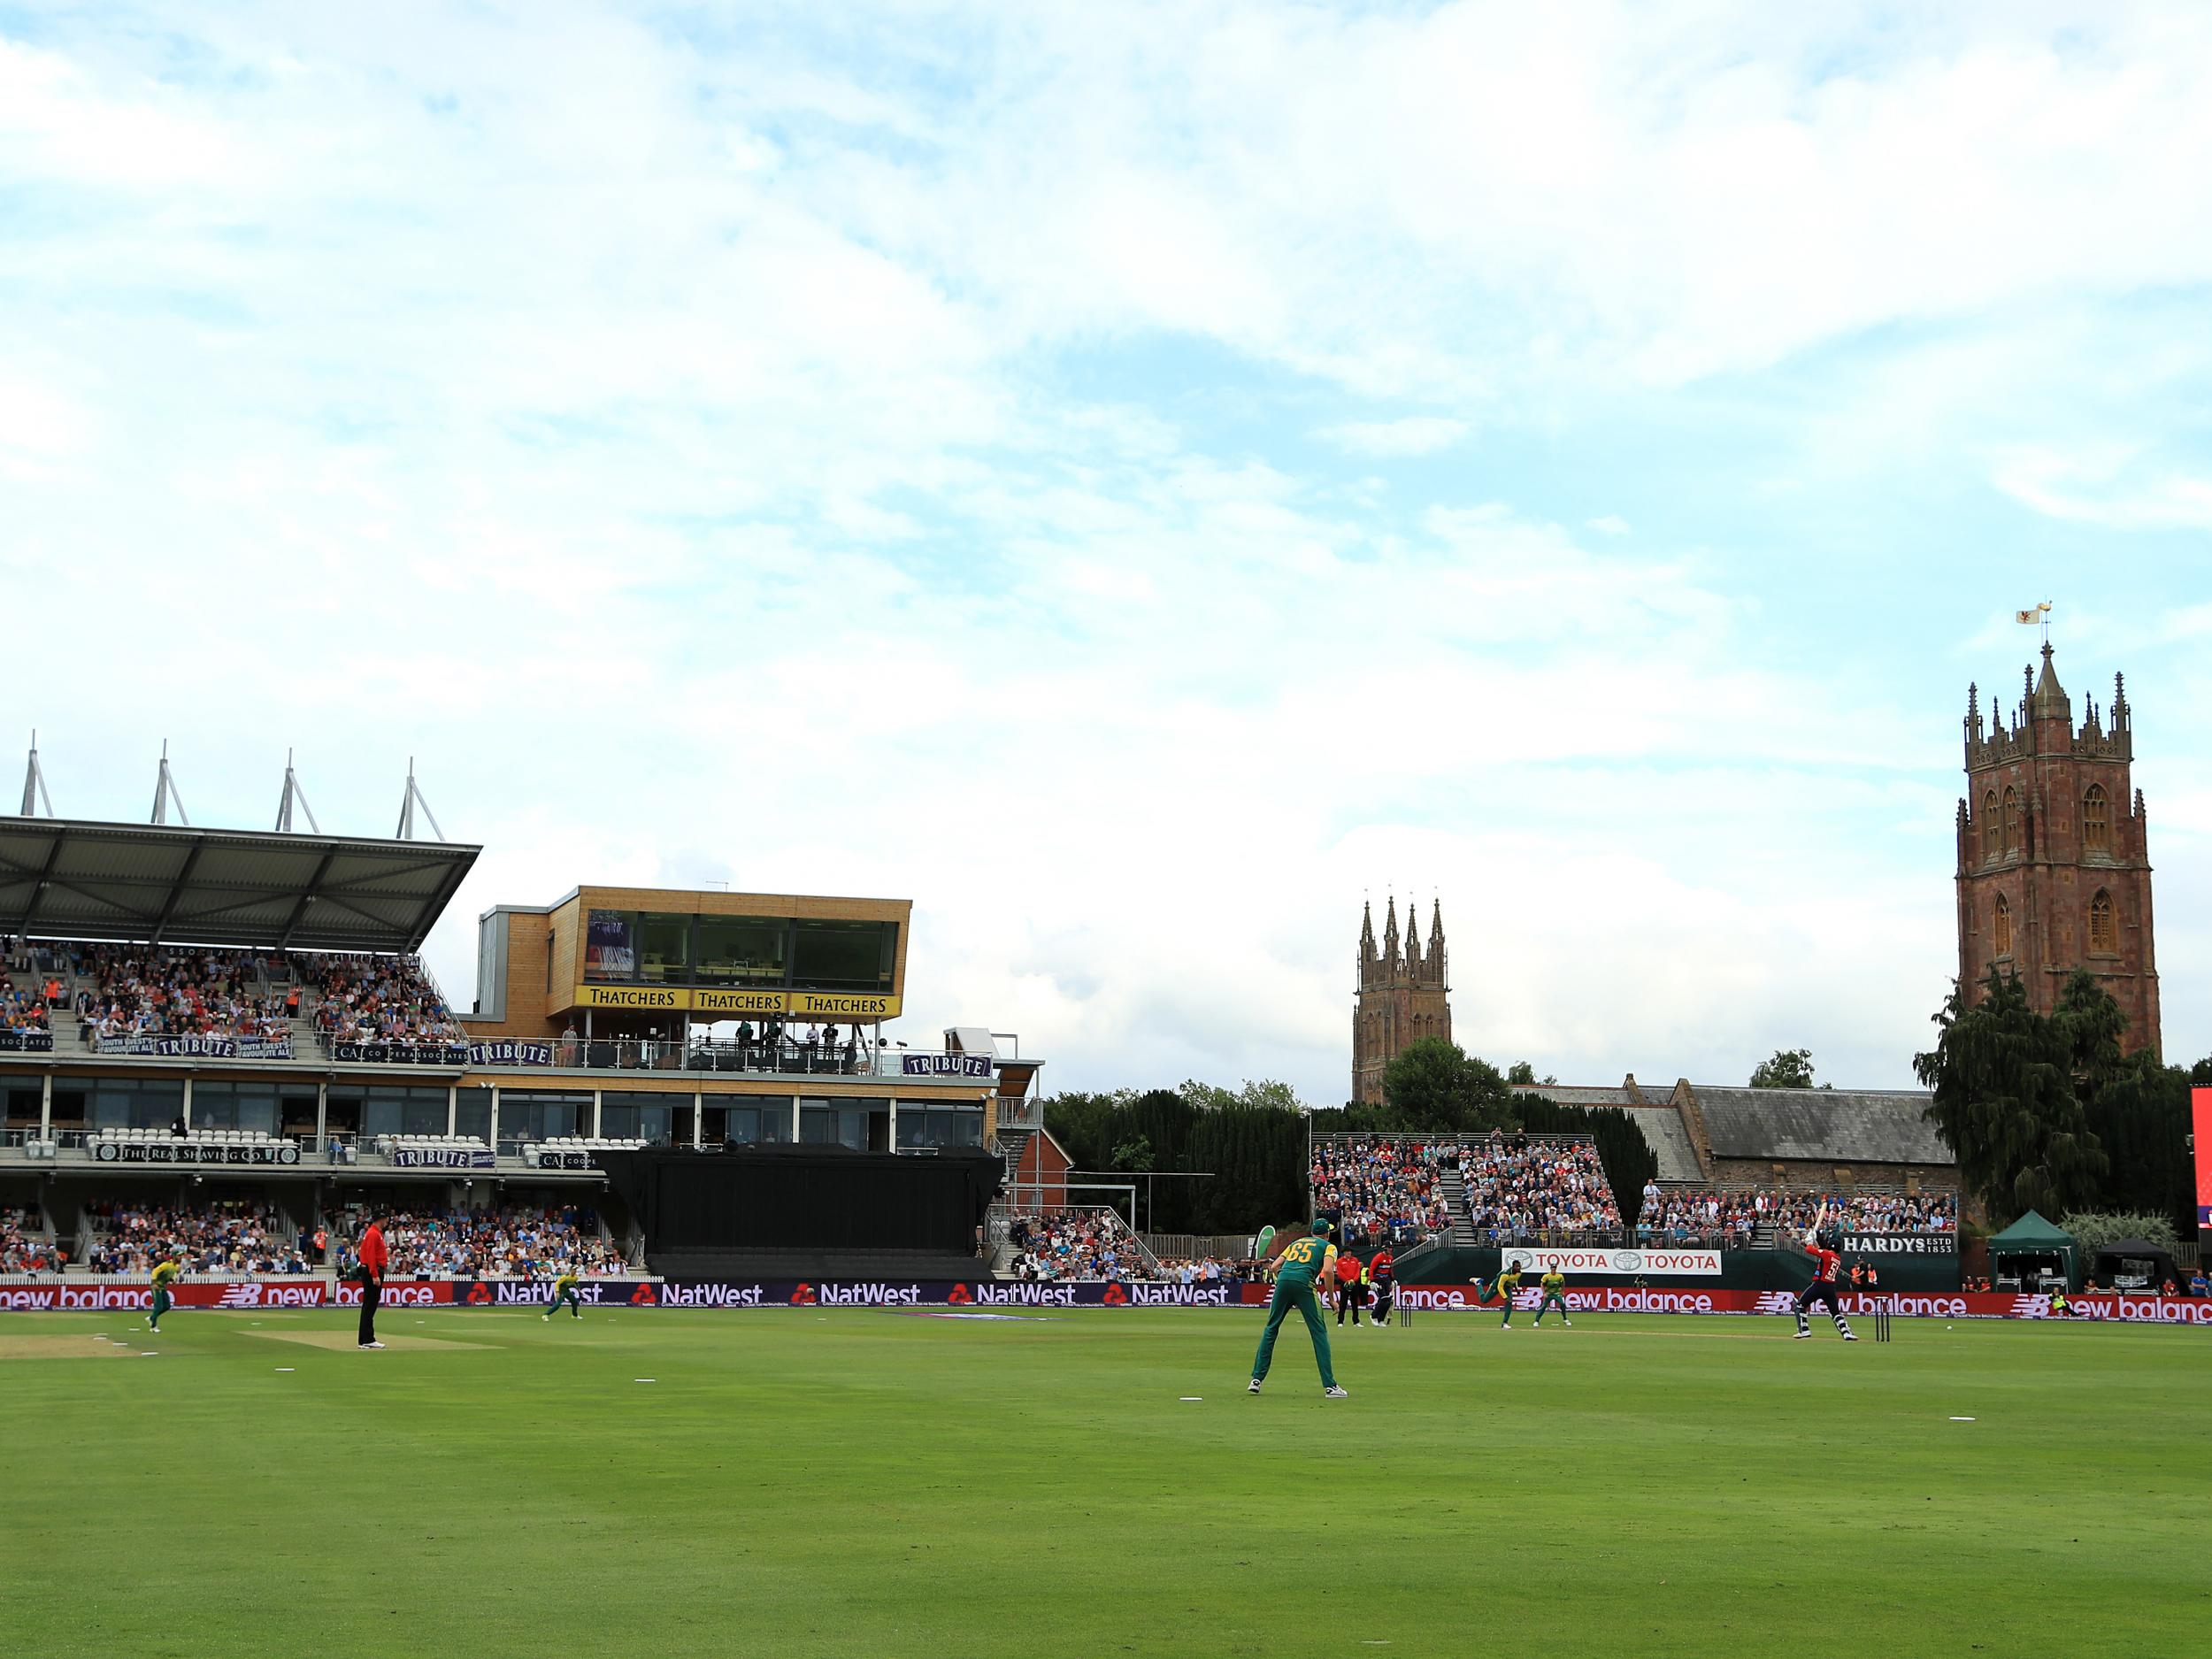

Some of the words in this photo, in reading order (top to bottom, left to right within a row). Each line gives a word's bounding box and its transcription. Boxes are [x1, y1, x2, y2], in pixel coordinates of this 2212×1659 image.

[590, 988, 674, 1006] THATCHERS
[698, 992, 781, 1010] THATCHERS
[804, 995, 886, 1013] THATCHERS
[159, 1039, 233, 1056] TRIBUTE
[469, 1044, 549, 1063] TRIBUTE
[910, 1056, 982, 1075] TRIBUTE
[124, 1148, 147, 1158] THE
[152, 1149, 180, 1159] REAL
[396, 1150, 467, 1167] TRIBUTE
[1286, 1242, 1317, 1263] 65
[1536, 1254, 1608, 1268] TOYOTA
[1644, 1255, 1717, 1269] TOYOTA
[267, 1287, 321, 1304] new
[662, 1284, 763, 1303] NatWest
[821, 1283, 920, 1302] NatWest
[978, 1284, 1076, 1303] NatWest
[1133, 1284, 1229, 1302] NatWest
[1607, 1288, 1712, 1310] balance
[1858, 1293, 1967, 1314] balance
